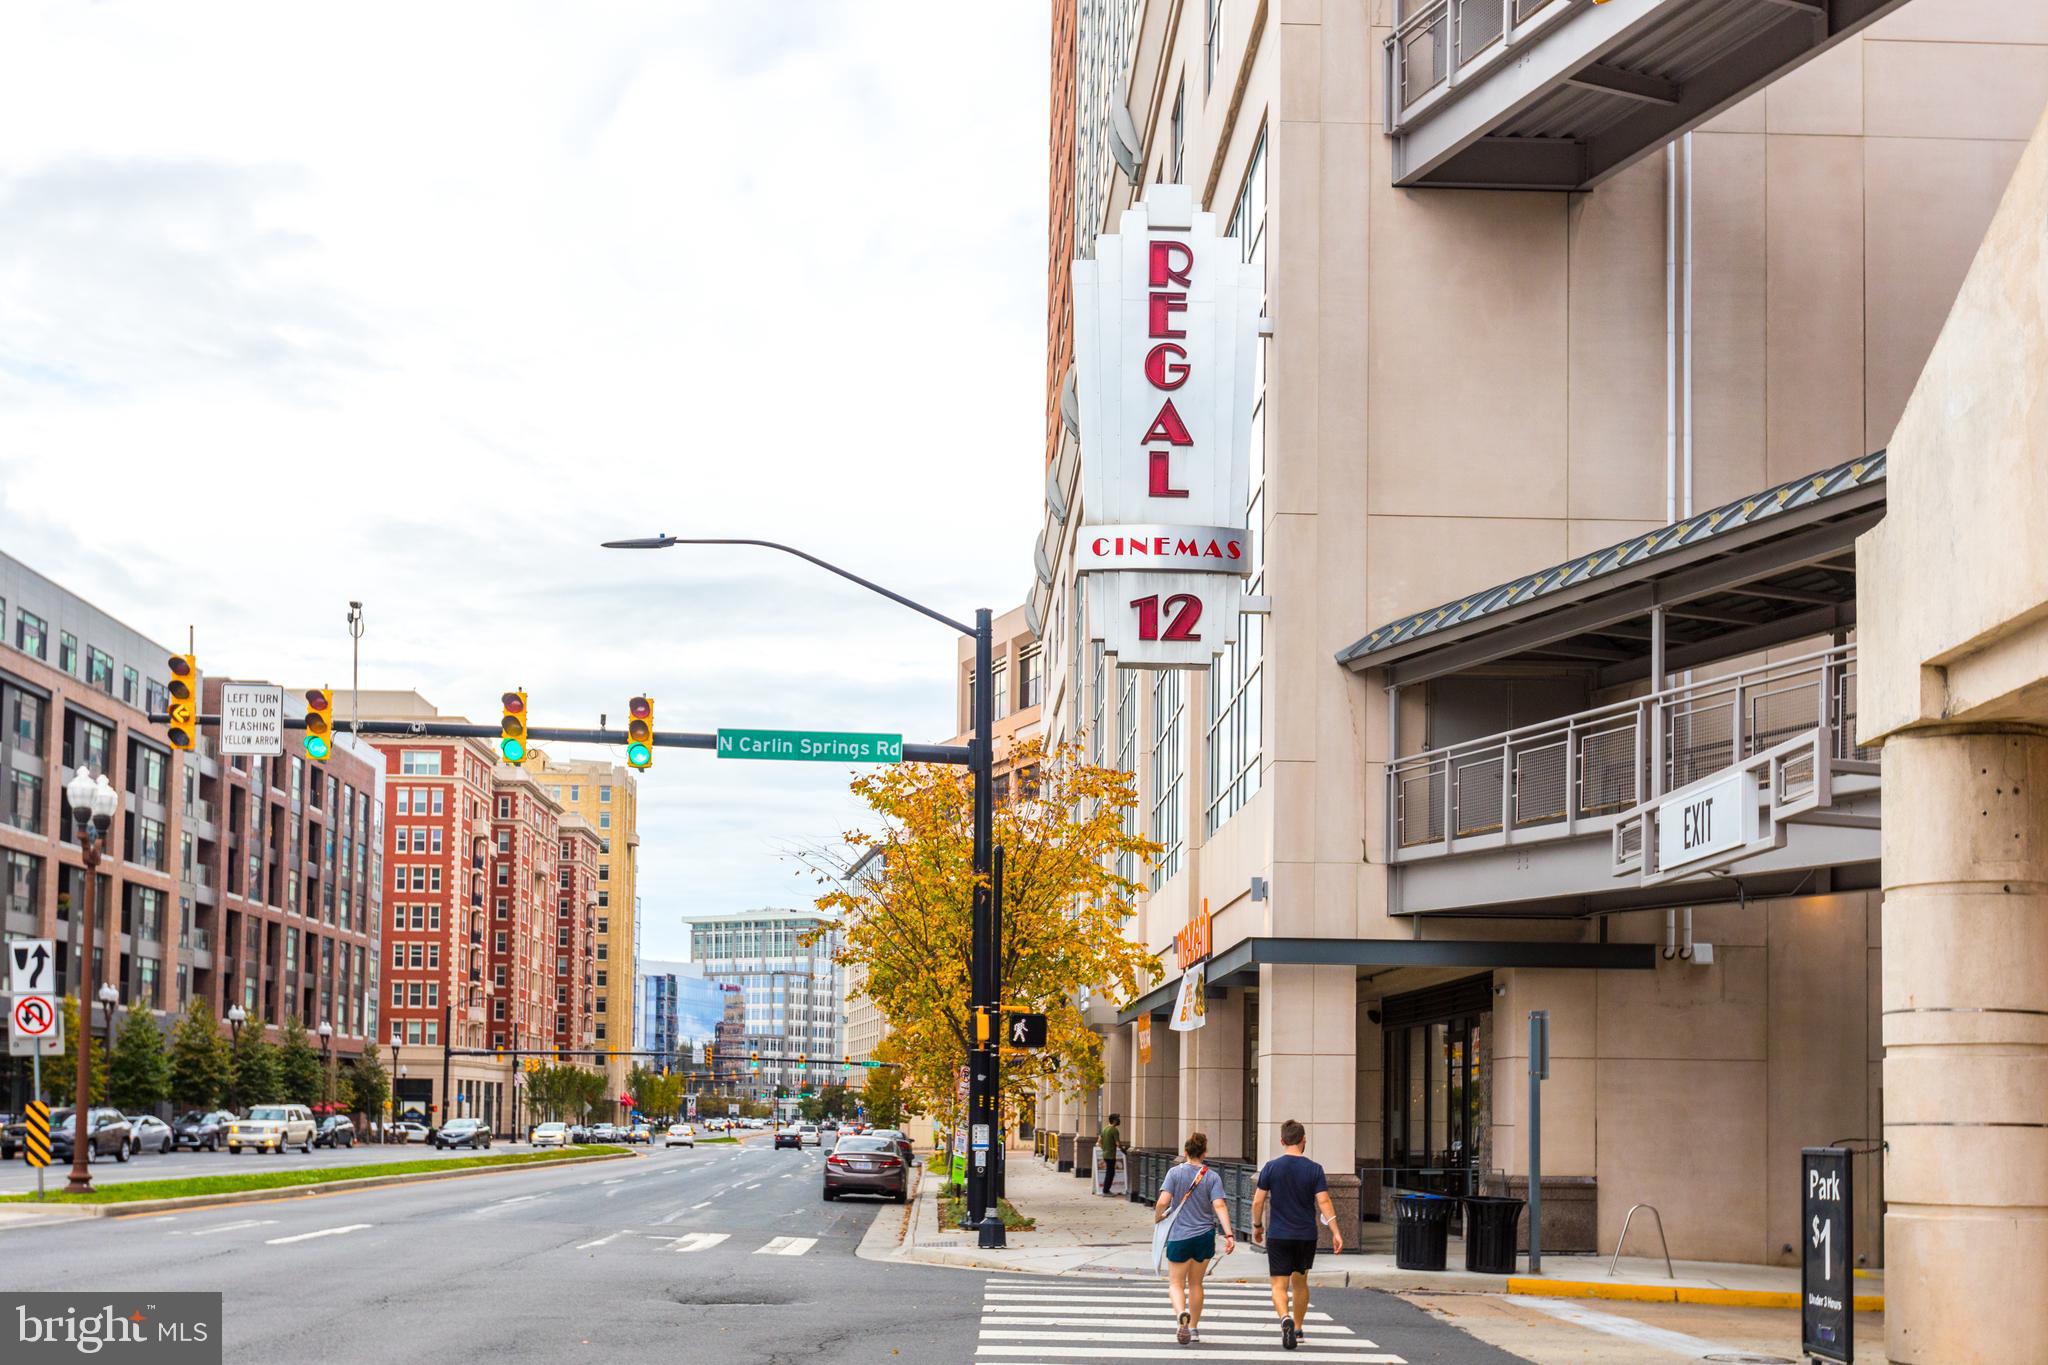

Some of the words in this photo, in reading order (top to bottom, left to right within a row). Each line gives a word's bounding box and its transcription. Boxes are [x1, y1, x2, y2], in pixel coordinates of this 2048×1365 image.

[1141, 241, 1194, 498] REGAL
[1092, 537, 1241, 560] CINEMAS
[1130, 593, 1203, 641] 12
[227, 693, 249, 703] LEFT
[255, 694, 279, 704] TURN
[230, 707, 258, 717] YIELD
[262, 707, 276, 718] ON
[229, 721, 275, 731] FLASHING
[224, 735, 252, 745] YELLOW
[255, 735, 280, 746] ARROW
[719, 736, 733, 751] N
[739, 737, 793, 753] Carlin
[800, 739, 870, 759] Springs
[876, 740, 900, 756] Rd
[1684, 797, 1714, 850] EXIT
[1809, 1169, 1840, 1201] Park
[1812, 1214, 1831, 1281] $1
[1808, 1292, 1823, 1306] Under
[1823, 1295, 1828, 1308] 3
[1828, 1296, 1842, 1311] Hours
